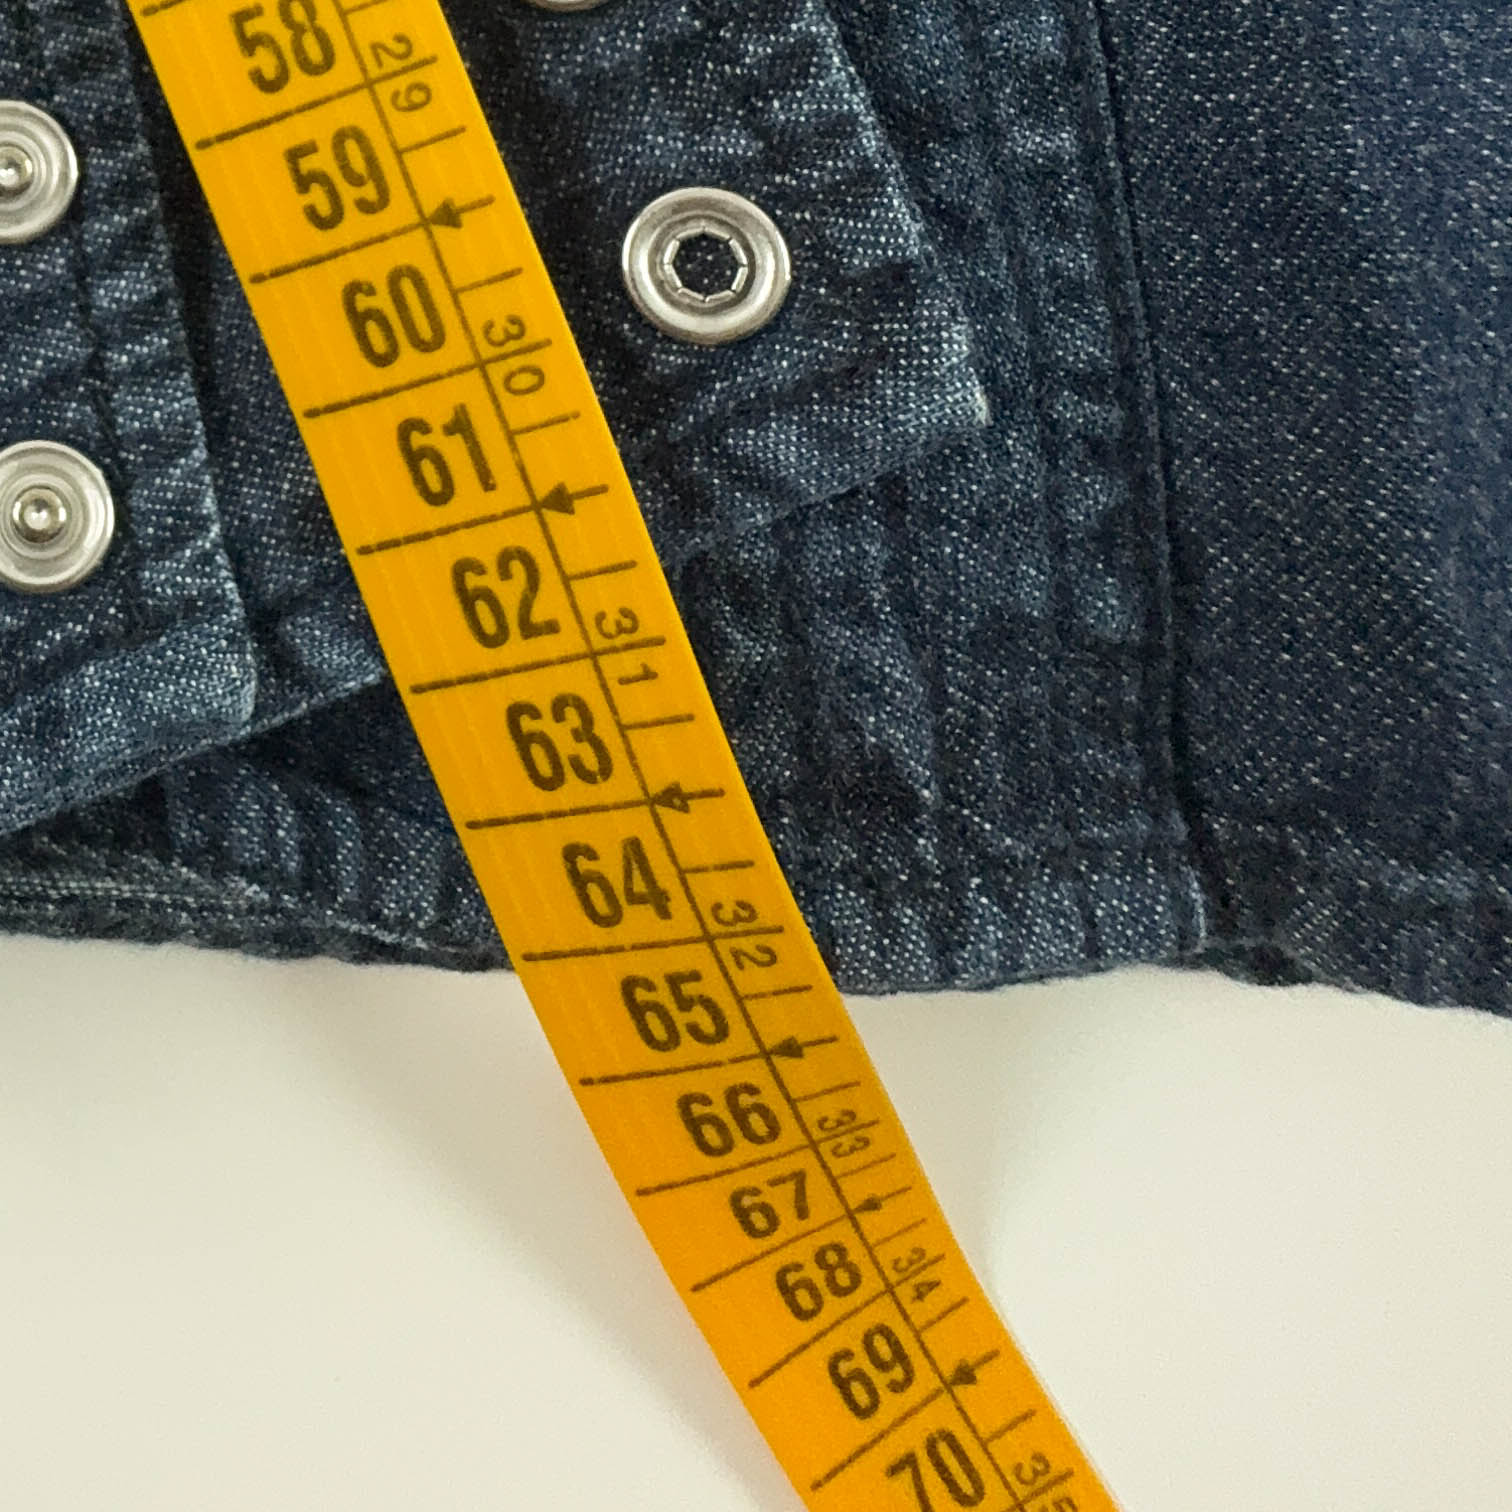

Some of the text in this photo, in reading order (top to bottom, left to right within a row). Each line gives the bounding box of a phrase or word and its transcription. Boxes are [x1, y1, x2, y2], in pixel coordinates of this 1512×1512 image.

[370, 33, 432, 114] 29
[283, 124, 391, 232] 59
[341, 264, 447, 369] 60
[483, 314, 546, 396] 30
[396, 403, 498, 508] 61
[450, 545, 561, 650] 62
[594, 607, 659, 686] 31
[505, 693, 615, 793] 63
[561, 835, 674, 929] 64
[710, 900, 779, 970] 32
[619, 969, 732, 1054] 65
[675, 1082, 783, 1159] 66
[817, 1108, 871, 1160] 33
[728, 1168, 814, 1240] 67
[774, 1240, 863, 1323] 68
[890, 1246, 943, 1304] 34
[826, 1322, 916, 1421] 69
[884, 1429, 986, 1512] 70
